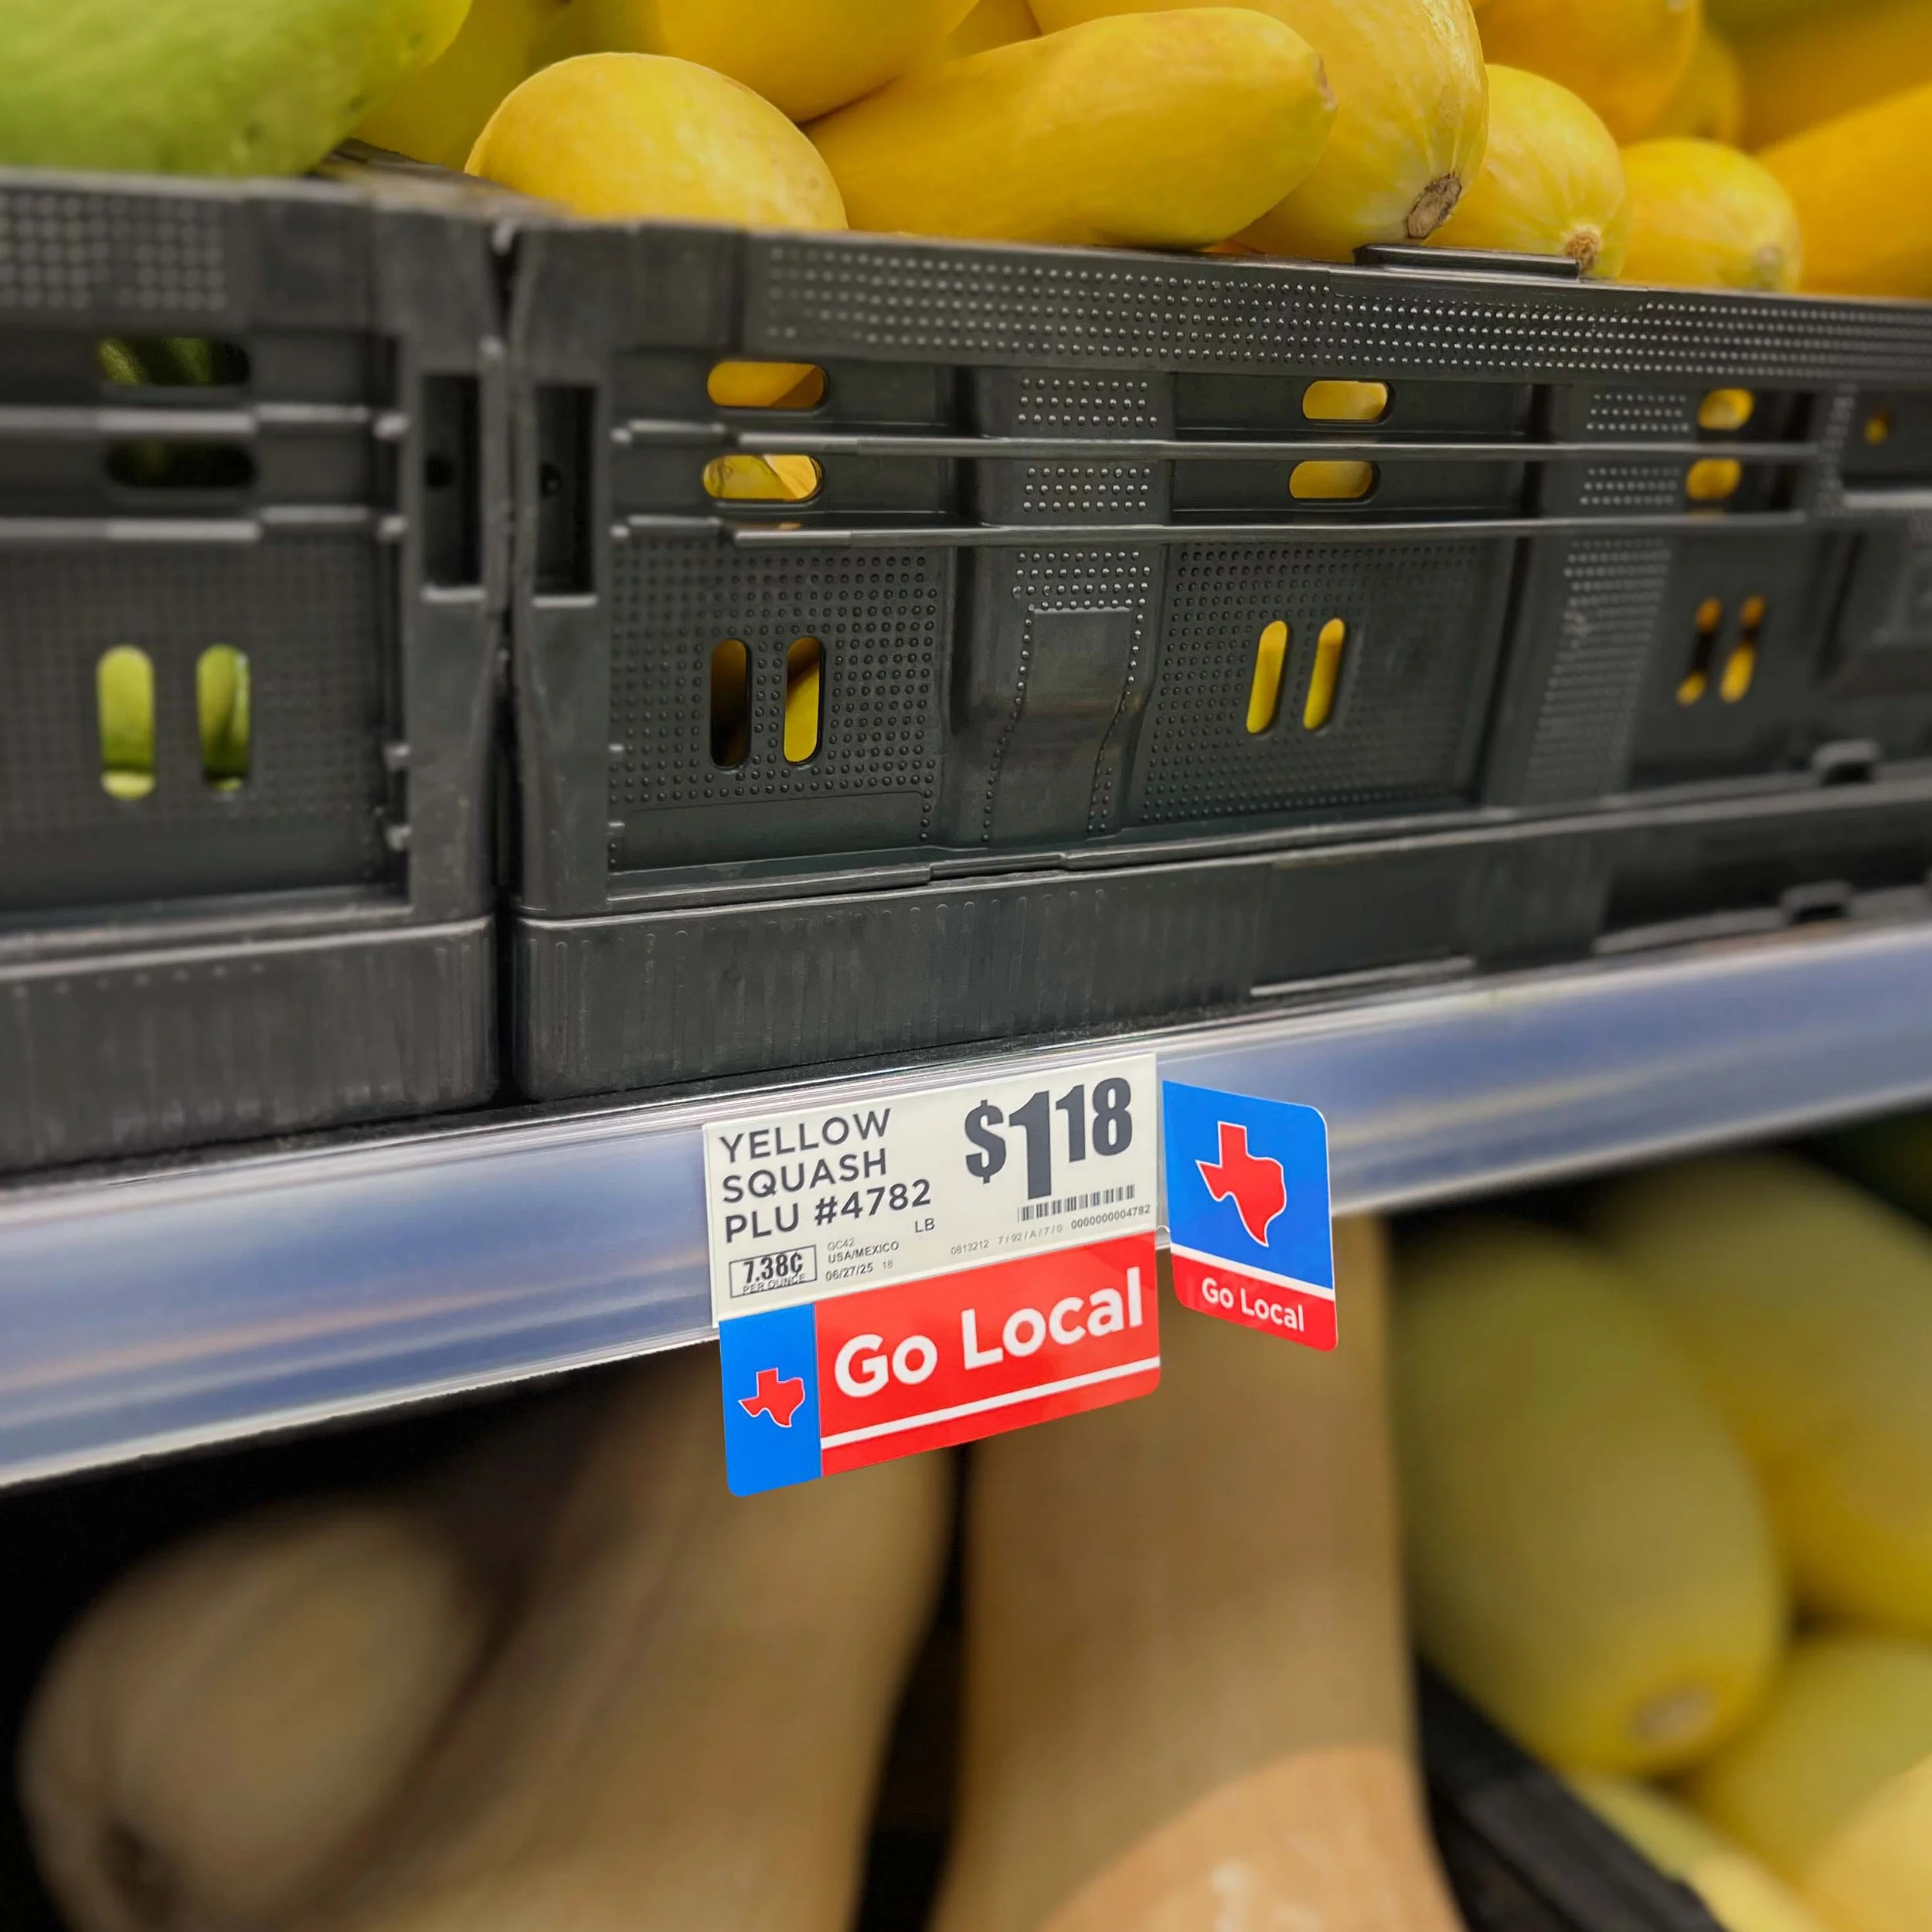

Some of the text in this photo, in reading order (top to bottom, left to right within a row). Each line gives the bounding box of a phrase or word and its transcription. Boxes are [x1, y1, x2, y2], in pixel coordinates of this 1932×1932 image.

[719, 1108, 891, 1164] YELLOW
[723, 1148, 886, 1202] SQUASH
[726, 1179, 931, 1243] PLU #4782
[914, 1218, 935, 1234] LB
[827, 1237, 855, 1251] GC42
[828, 1240, 900, 1264] USA/MEXICO
[743, 1252, 803, 1283] 7.38¢
[825, 1262, 873, 1281] 06/27/25
[743, 1274, 805, 1295] PER OUNCE
[1201, 1276, 1304, 1332] Go Local
[834, 1266, 1143, 1398] Go Local
